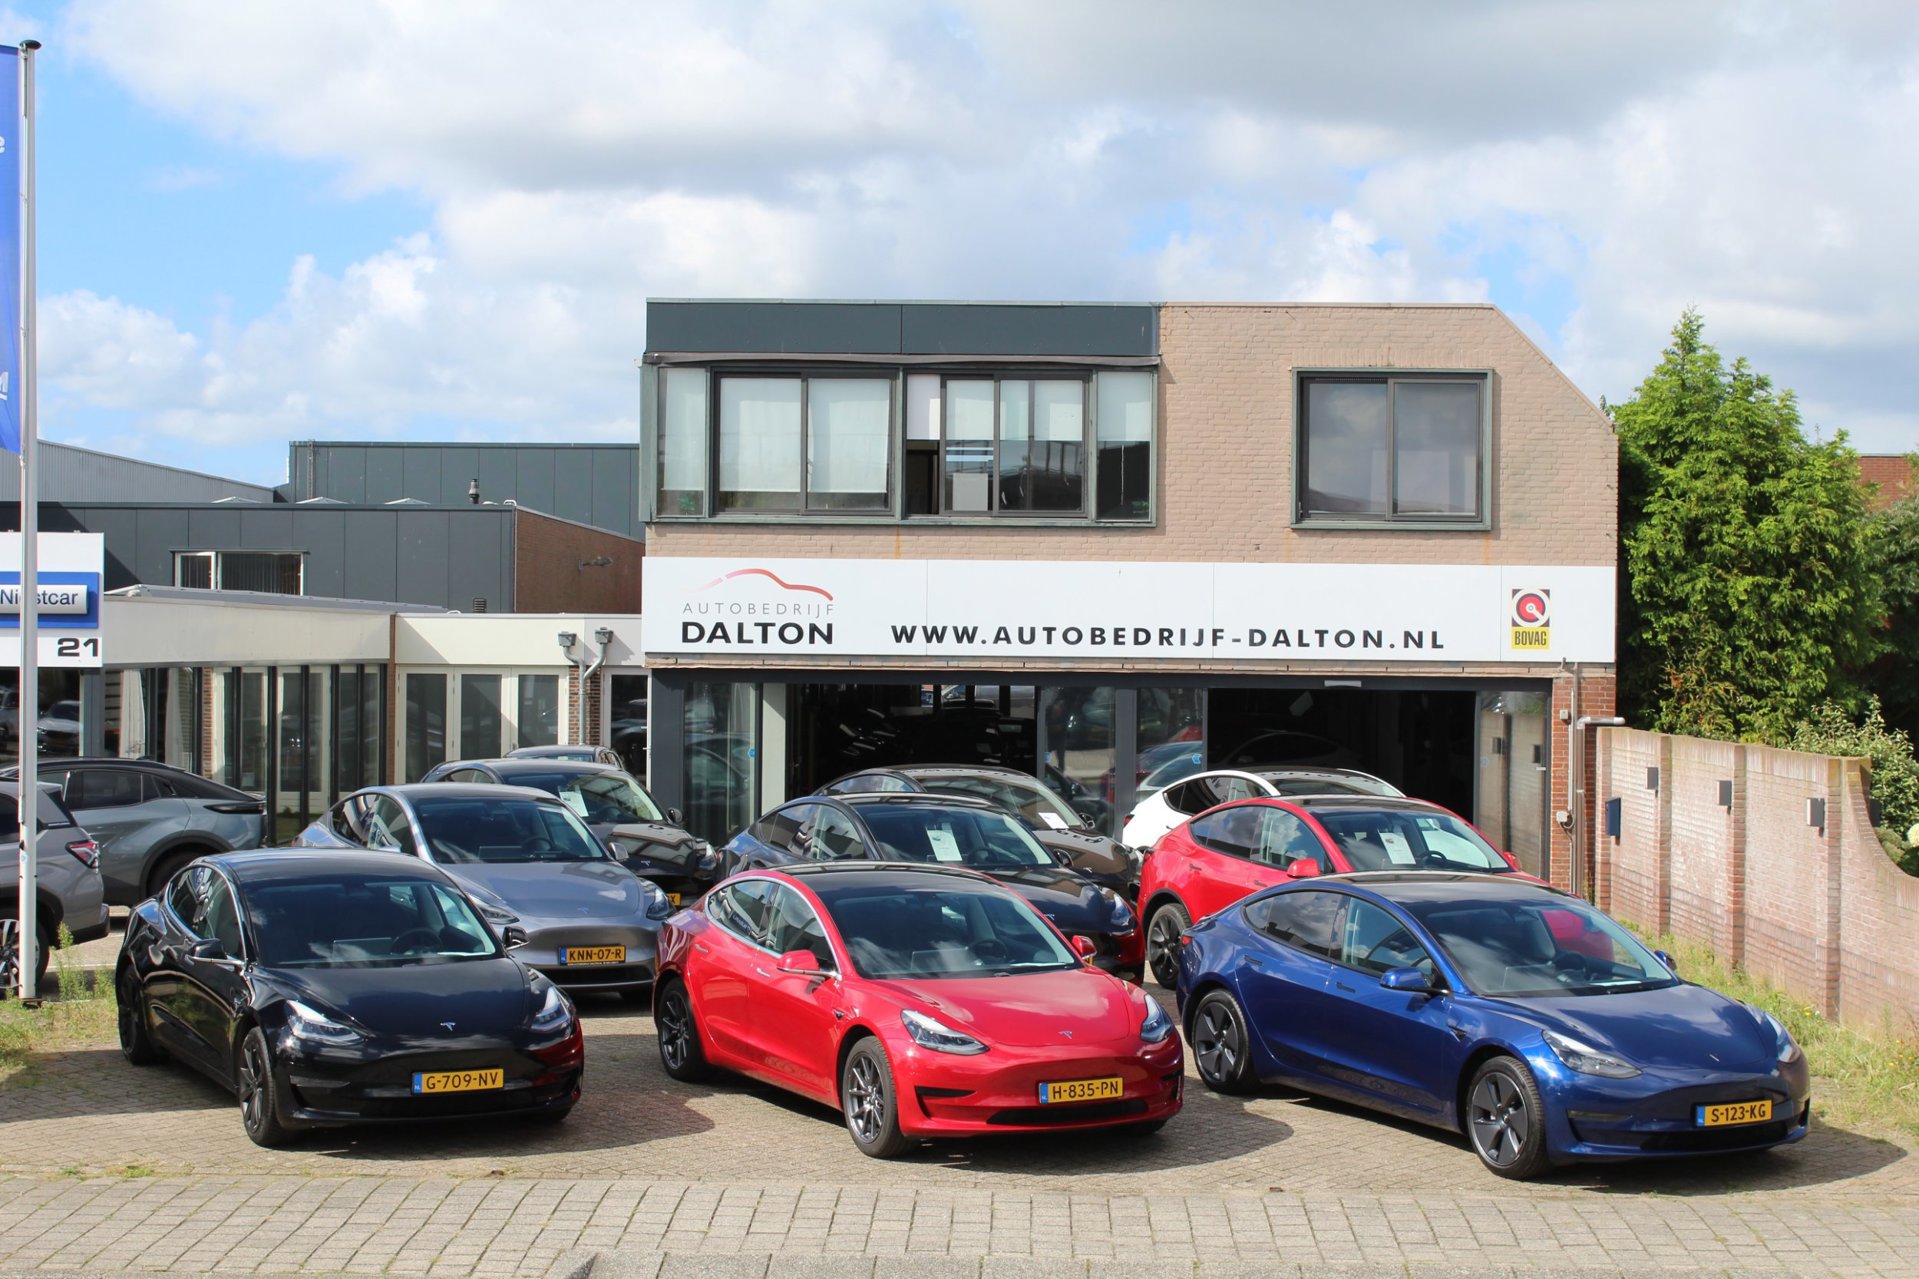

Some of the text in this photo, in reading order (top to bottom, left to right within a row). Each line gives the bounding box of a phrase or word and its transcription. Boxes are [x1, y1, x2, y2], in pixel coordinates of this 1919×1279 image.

[0, 589, 78, 605] Nitcar
[682, 602, 834, 618] AUTOBEDRIJF
[681, 621, 833, 645] DALTON
[891, 625, 1444, 649] WWW.AUTOBEDRIJF-DALTON.NL
[1514, 630, 1547, 646] BOVAG
[57, 637, 98, 657] 21
[569, 948, 622, 961] KNN-07-R
[426, 1071, 498, 1090] G-709-NV
[1052, 1080, 1118, 1099] H-835-PN
[1711, 1103, 1766, 1122] S-123-KG
